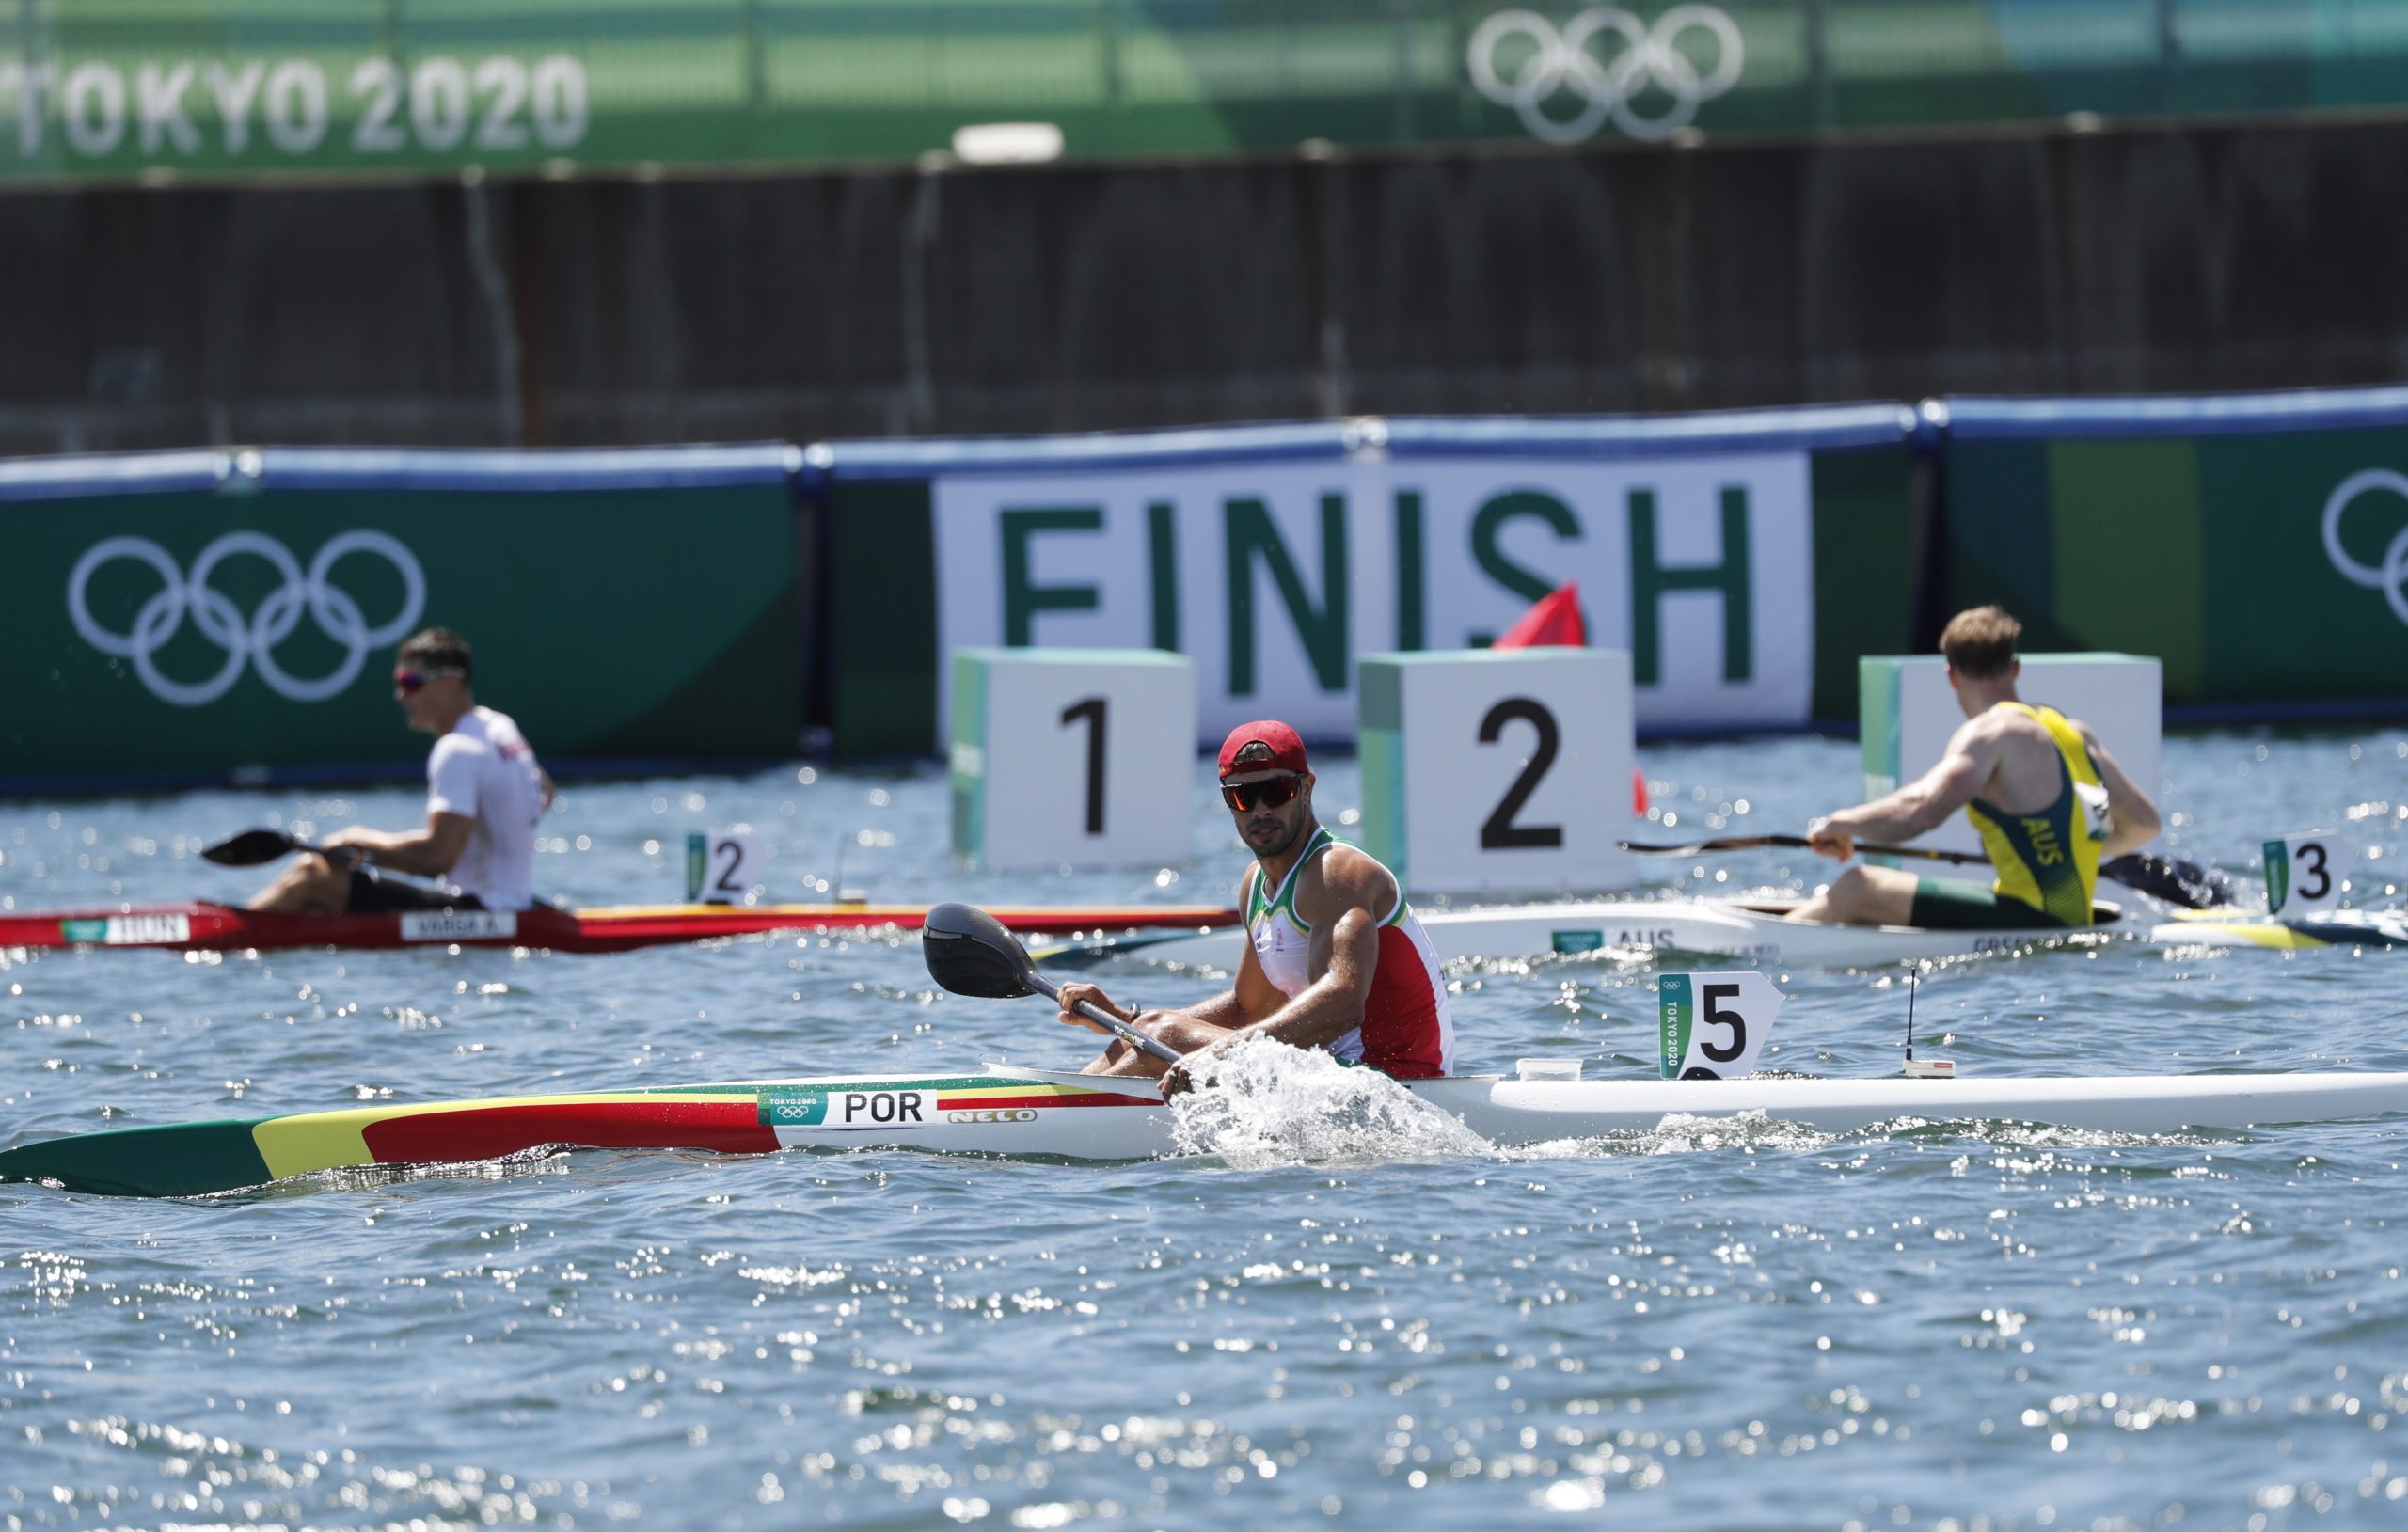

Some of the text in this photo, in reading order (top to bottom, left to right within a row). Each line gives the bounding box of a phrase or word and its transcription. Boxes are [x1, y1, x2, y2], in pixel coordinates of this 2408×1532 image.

[3, 56, 591, 157] TOKYO 2020
[999, 484, 1755, 696] FINISH
[1060, 698, 1109, 835] 1
[1477, 697, 1564, 849] 2
[716, 840, 742, 892] 2
[2021, 817, 2065, 866] AUS
[2296, 843, 2332, 901] 3
[120, 914, 178, 942] HUN
[1620, 927, 1676, 951] AUS
[1667, 1001, 1679, 1066] TOKYO 2020
[1700, 984, 1747, 1063] 5
[845, 1093, 924, 1123] POR
[949, 1110, 1036, 1123] NELO
